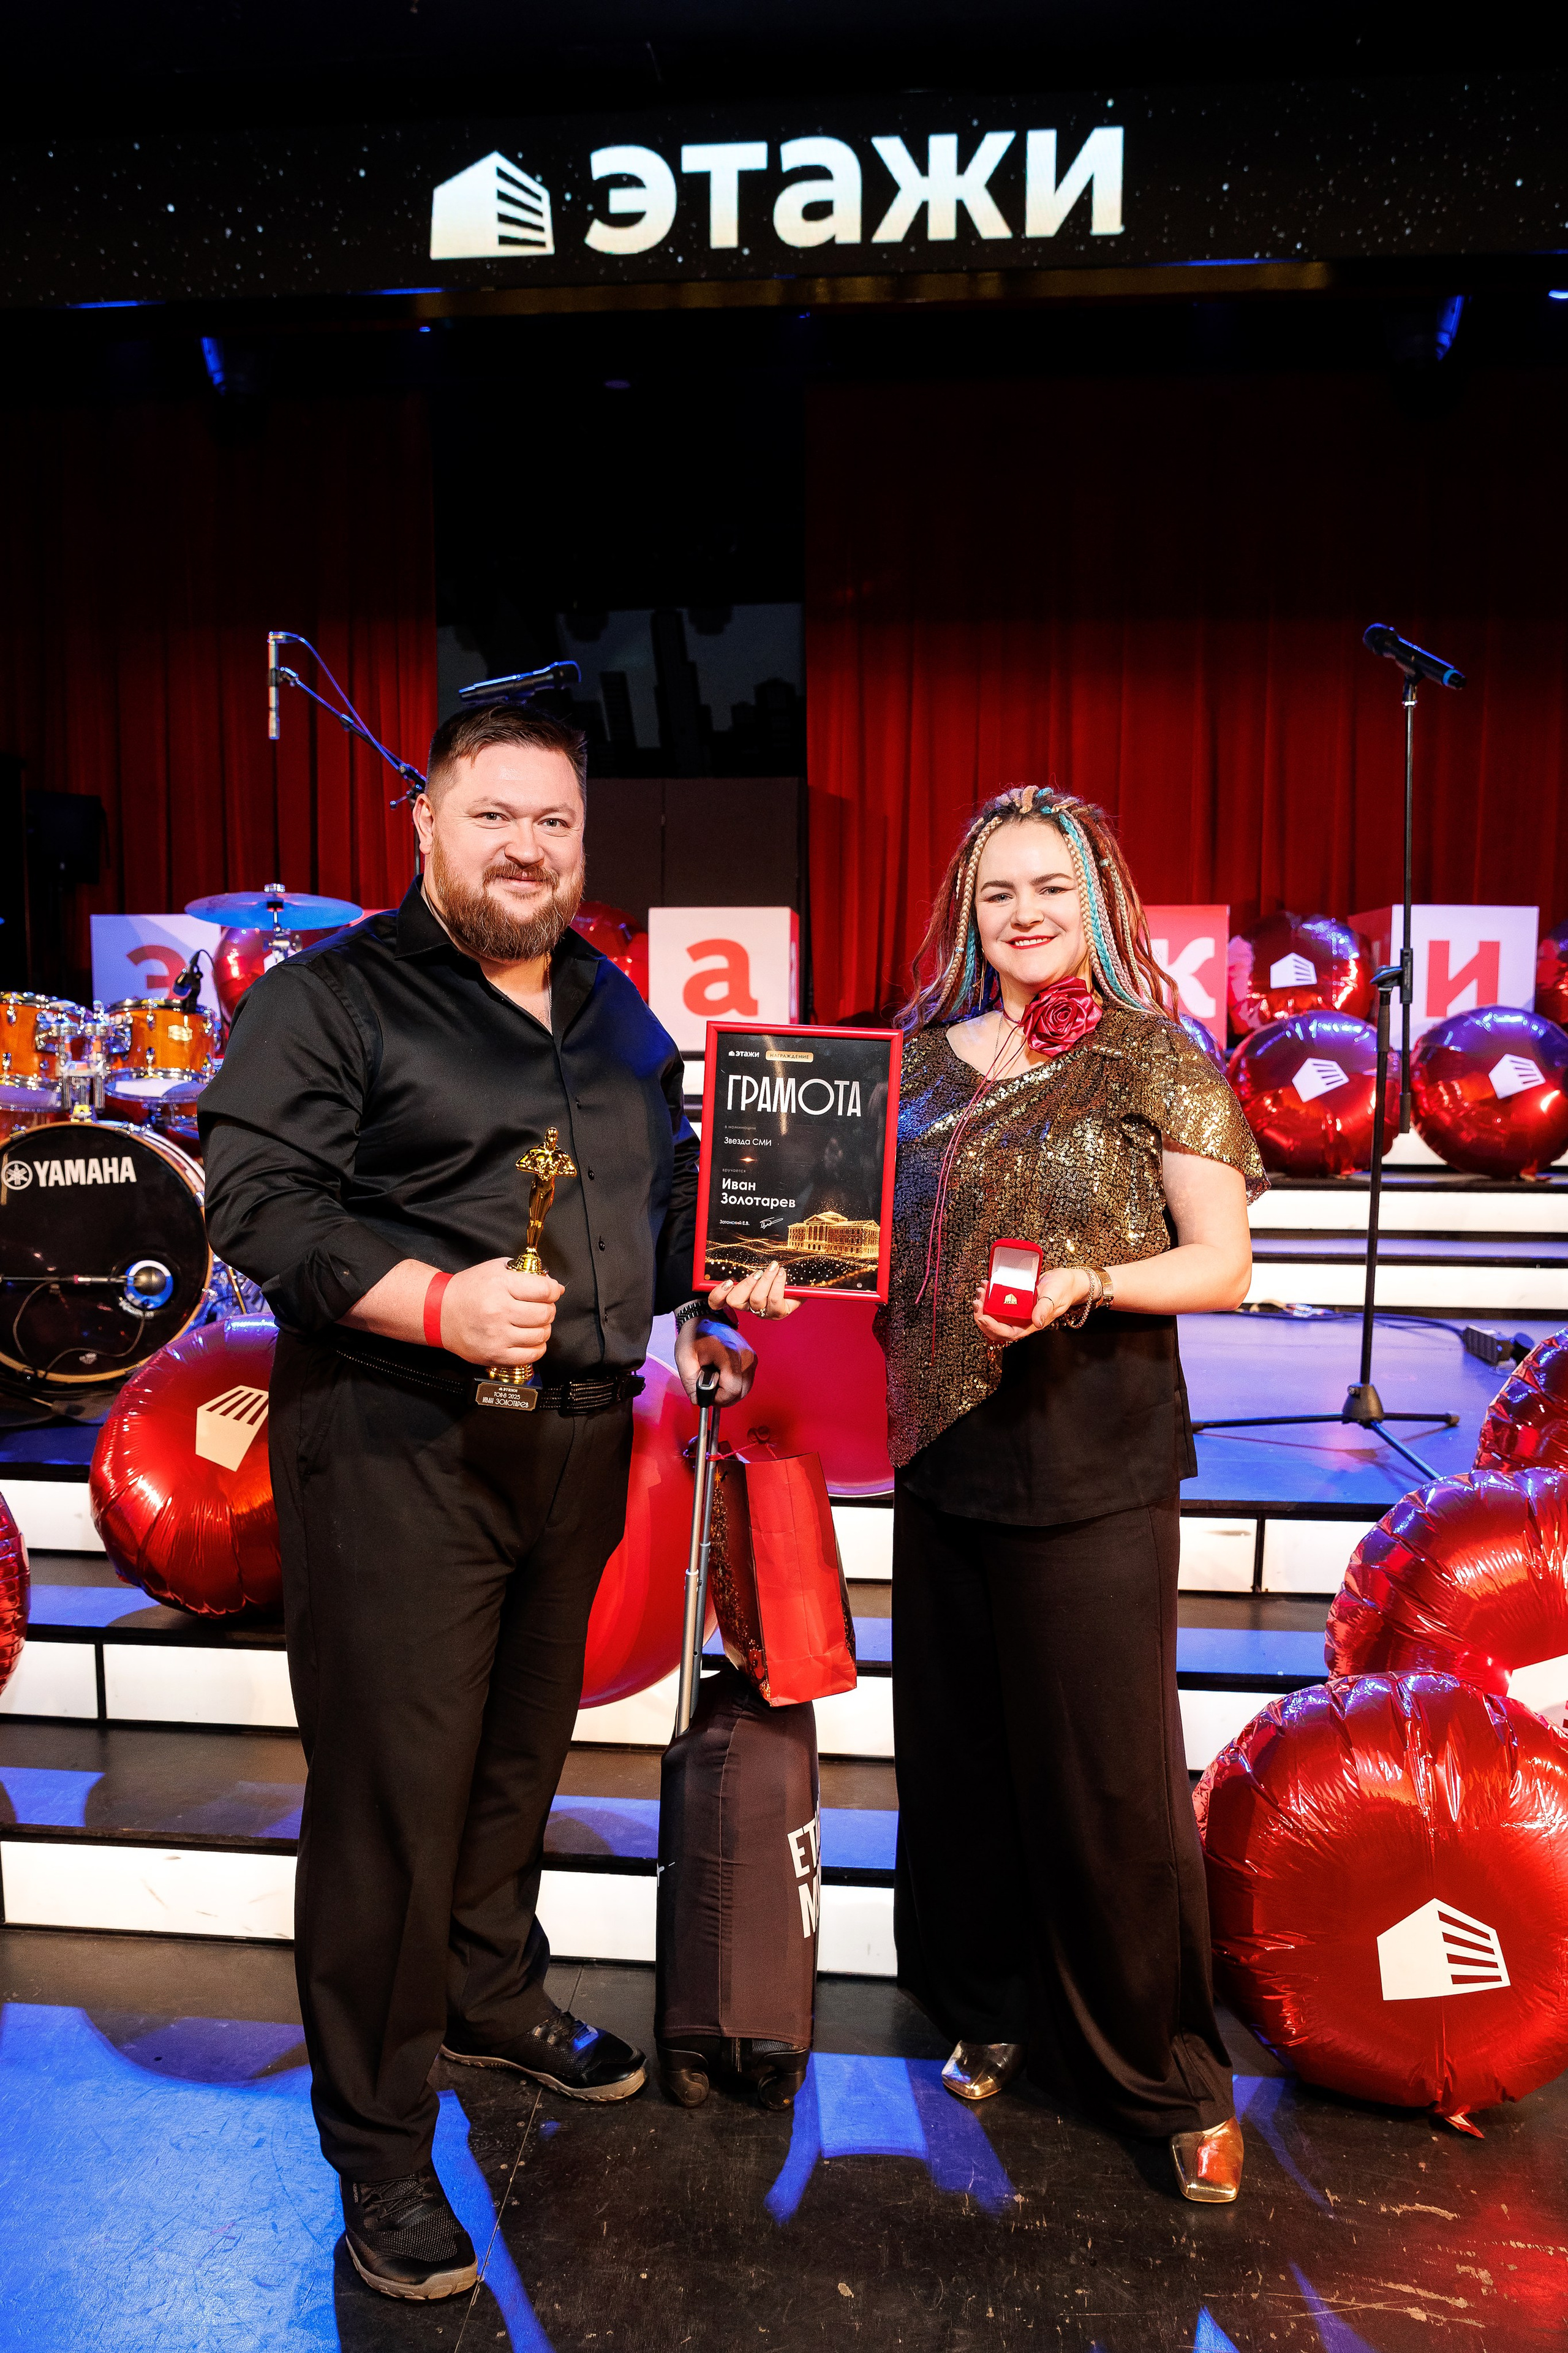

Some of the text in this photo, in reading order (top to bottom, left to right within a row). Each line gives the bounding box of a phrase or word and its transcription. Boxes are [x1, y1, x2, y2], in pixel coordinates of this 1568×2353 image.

[682, 938, 758, 1017] а
[726, 1074, 861, 1117] ГРАМОТА
[723, 1136, 750, 1145] Звезда
[33, 1156, 137, 1187] YAMAHA
[722, 1177, 756, 1191] Иван
[720, 1192, 796, 1209] Золотарев
